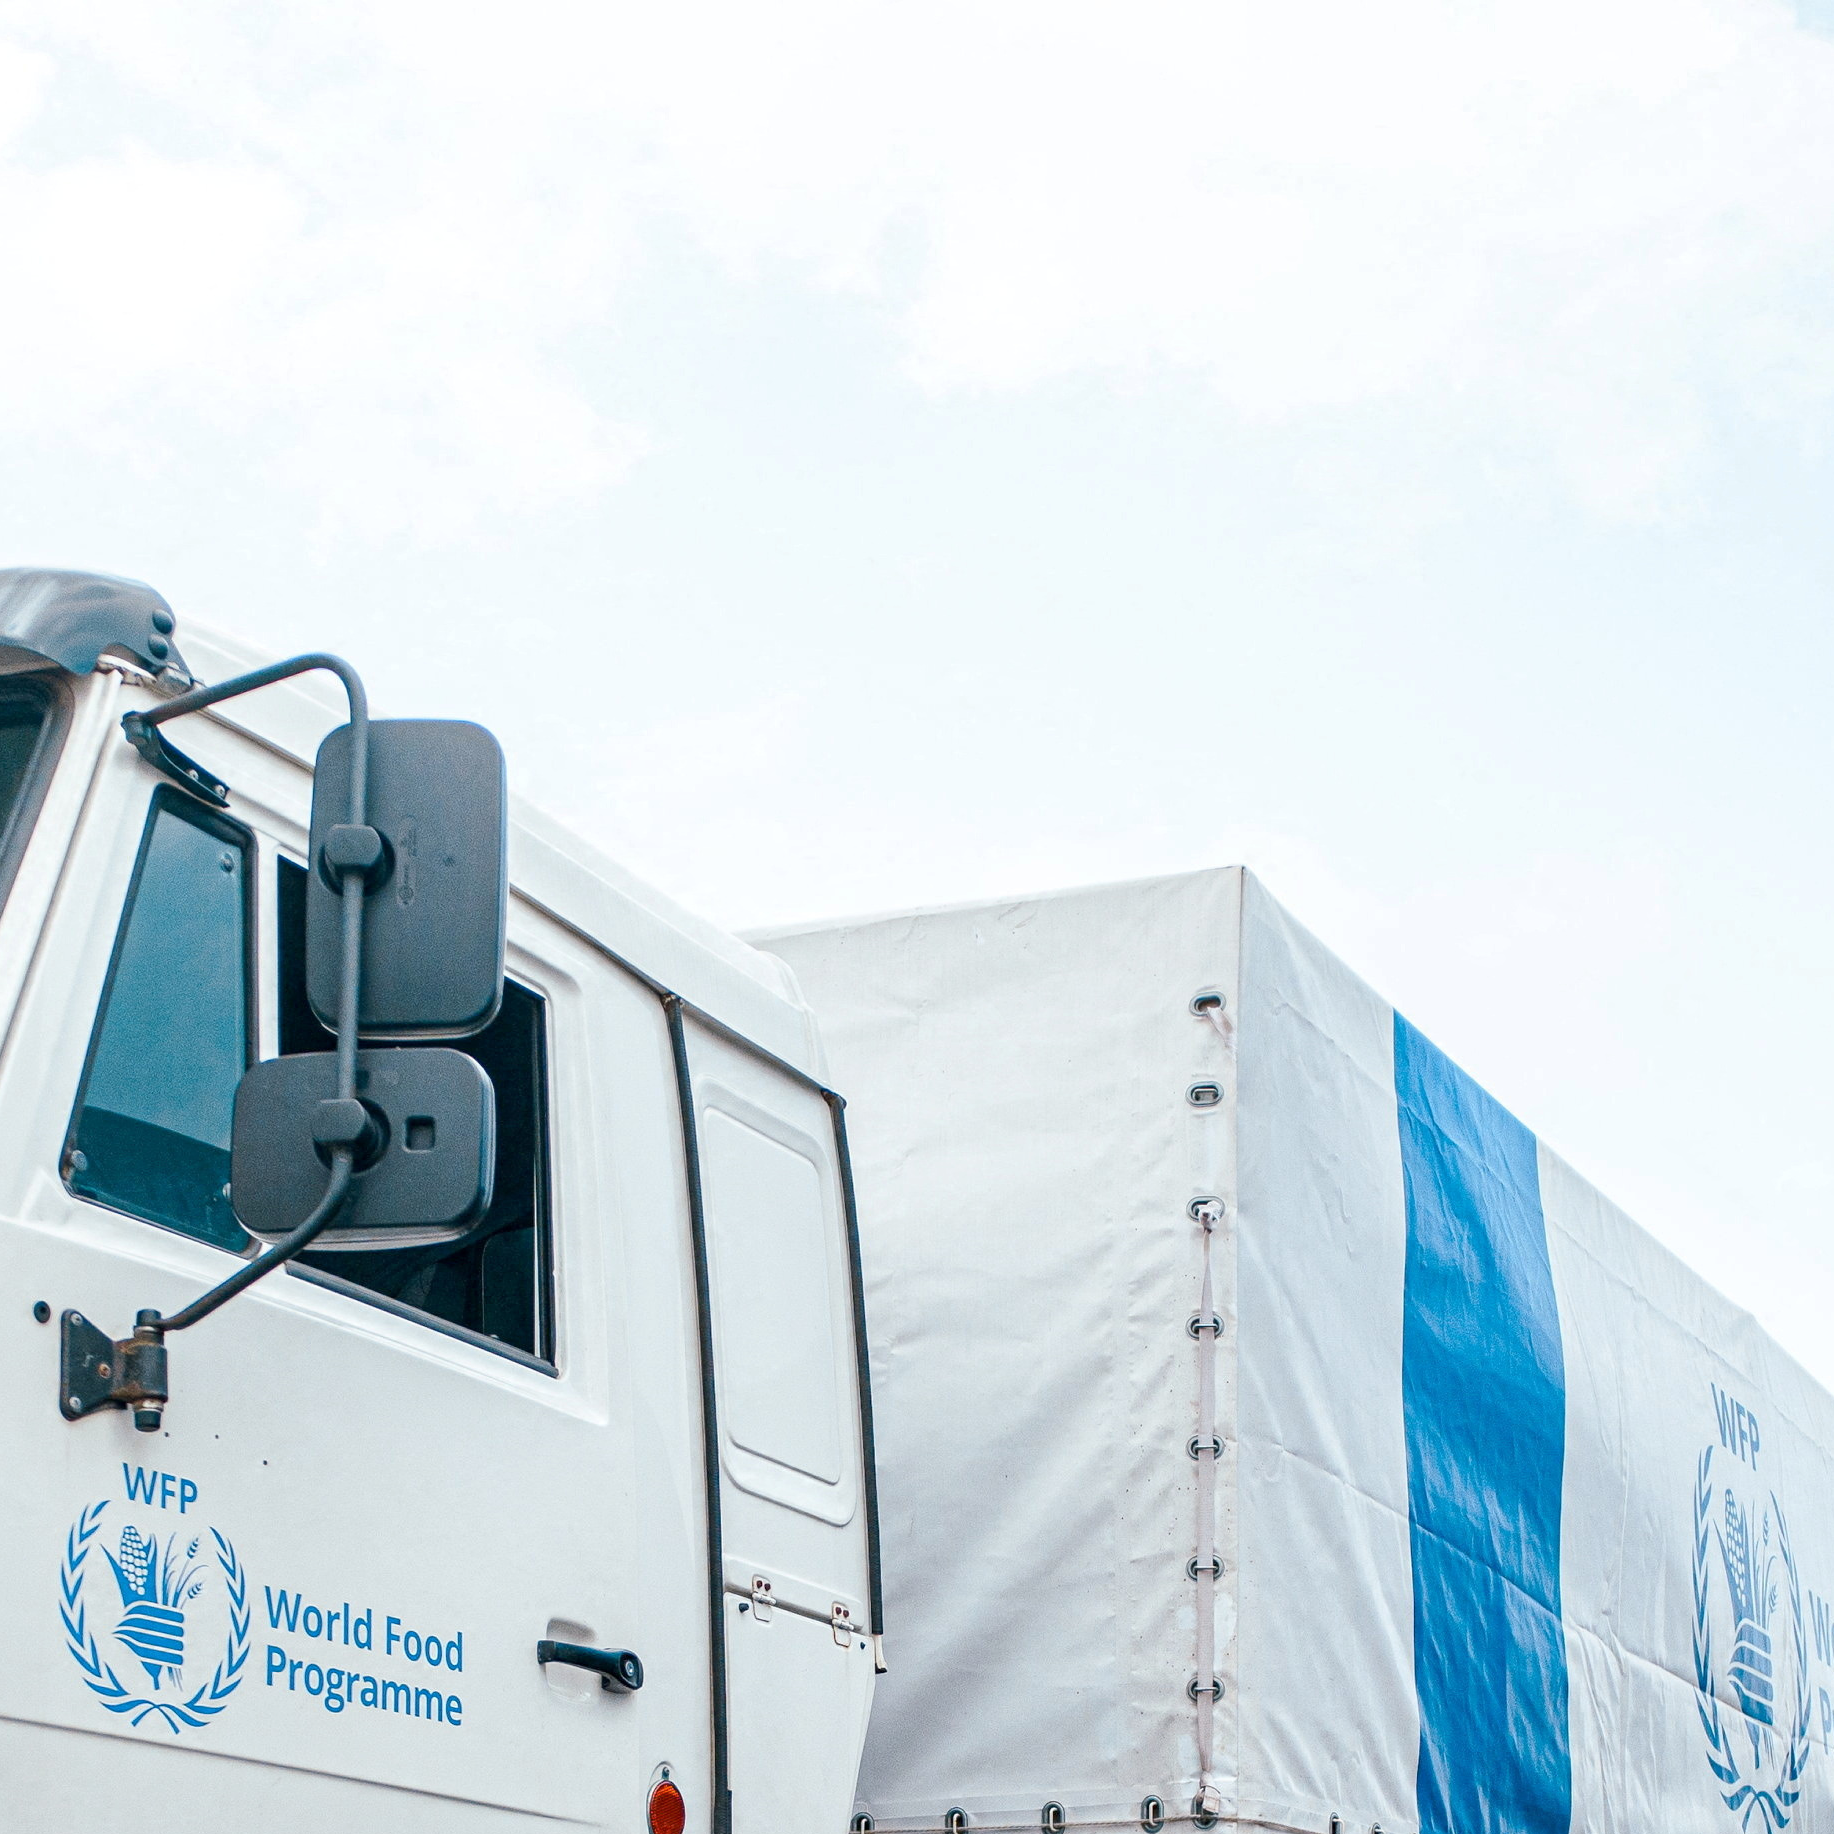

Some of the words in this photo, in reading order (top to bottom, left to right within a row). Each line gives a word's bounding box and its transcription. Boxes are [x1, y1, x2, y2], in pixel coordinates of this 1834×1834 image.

[1711, 1382, 1760, 1471] WFP
[123, 1462, 198, 1514] WFP
[264, 1585, 372, 1650] World
[386, 1616, 463, 1672] Food
[266, 1646, 463, 1726] Programme
